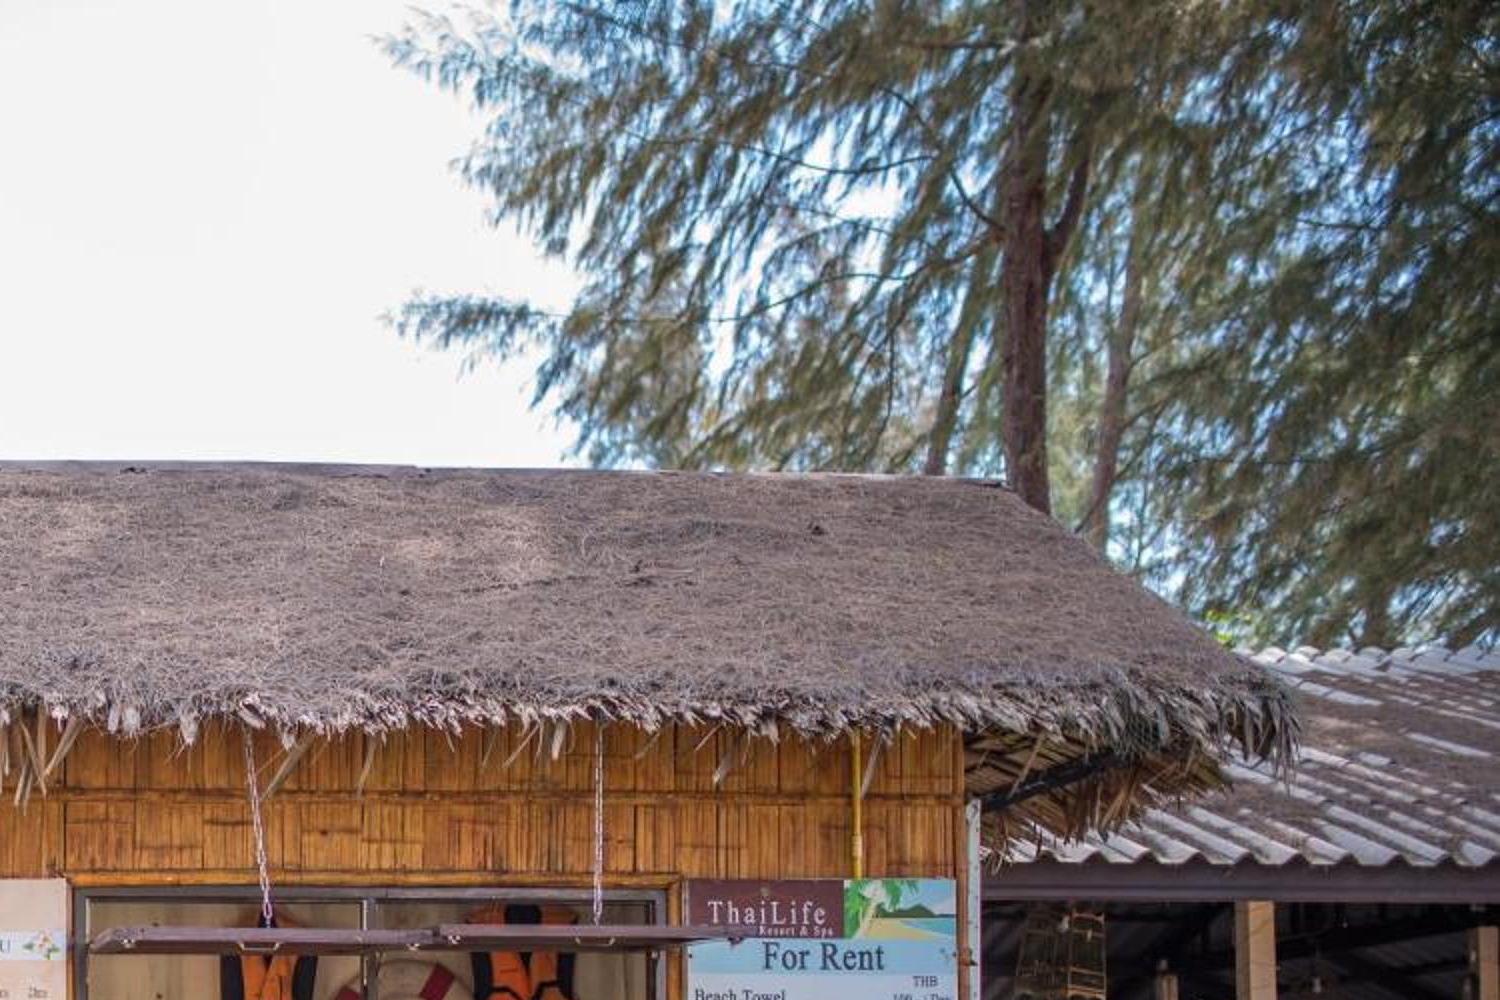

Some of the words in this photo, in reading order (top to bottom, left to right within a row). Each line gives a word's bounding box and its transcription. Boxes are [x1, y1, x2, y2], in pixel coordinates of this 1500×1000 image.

[707, 900, 826, 925] ThaiLife
[762, 941, 811, 971] For
[819, 942, 885, 971] Rent
[912, 975, 938, 988] THB
